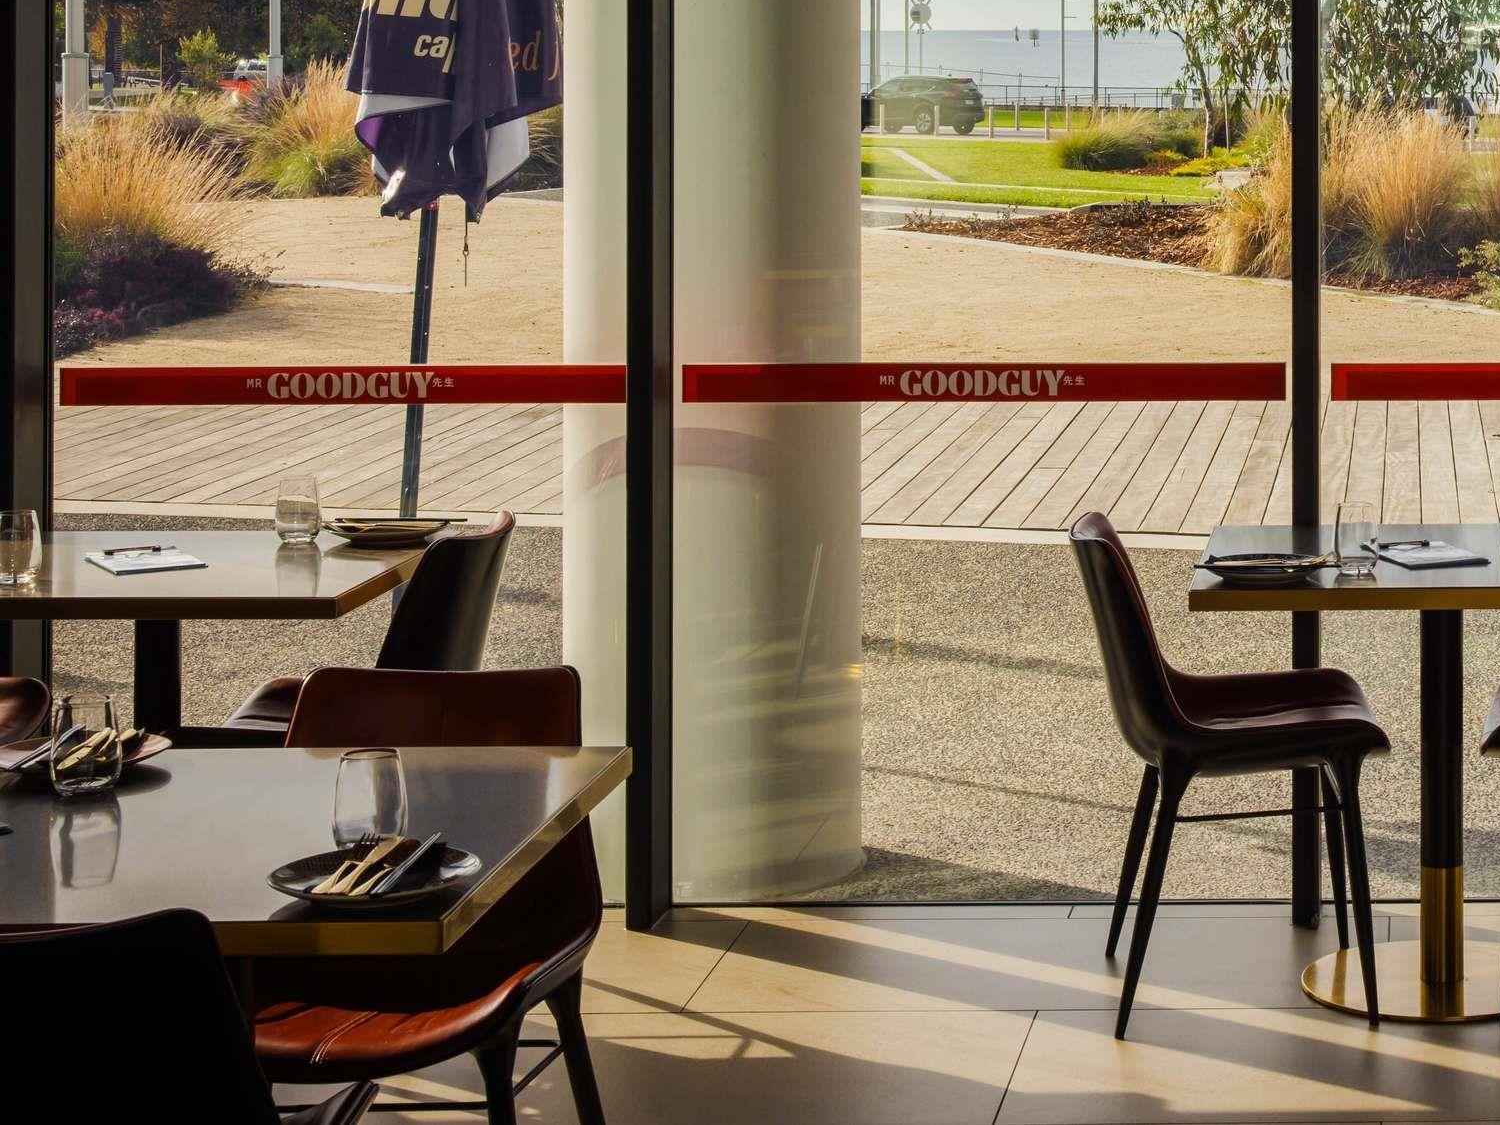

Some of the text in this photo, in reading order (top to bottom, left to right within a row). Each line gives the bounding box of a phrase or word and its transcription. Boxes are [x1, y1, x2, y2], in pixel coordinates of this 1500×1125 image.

[246, 372, 454, 399] MR GOODGUY 先生
[879, 369, 1085, 396] MR GOODGUY 先生
